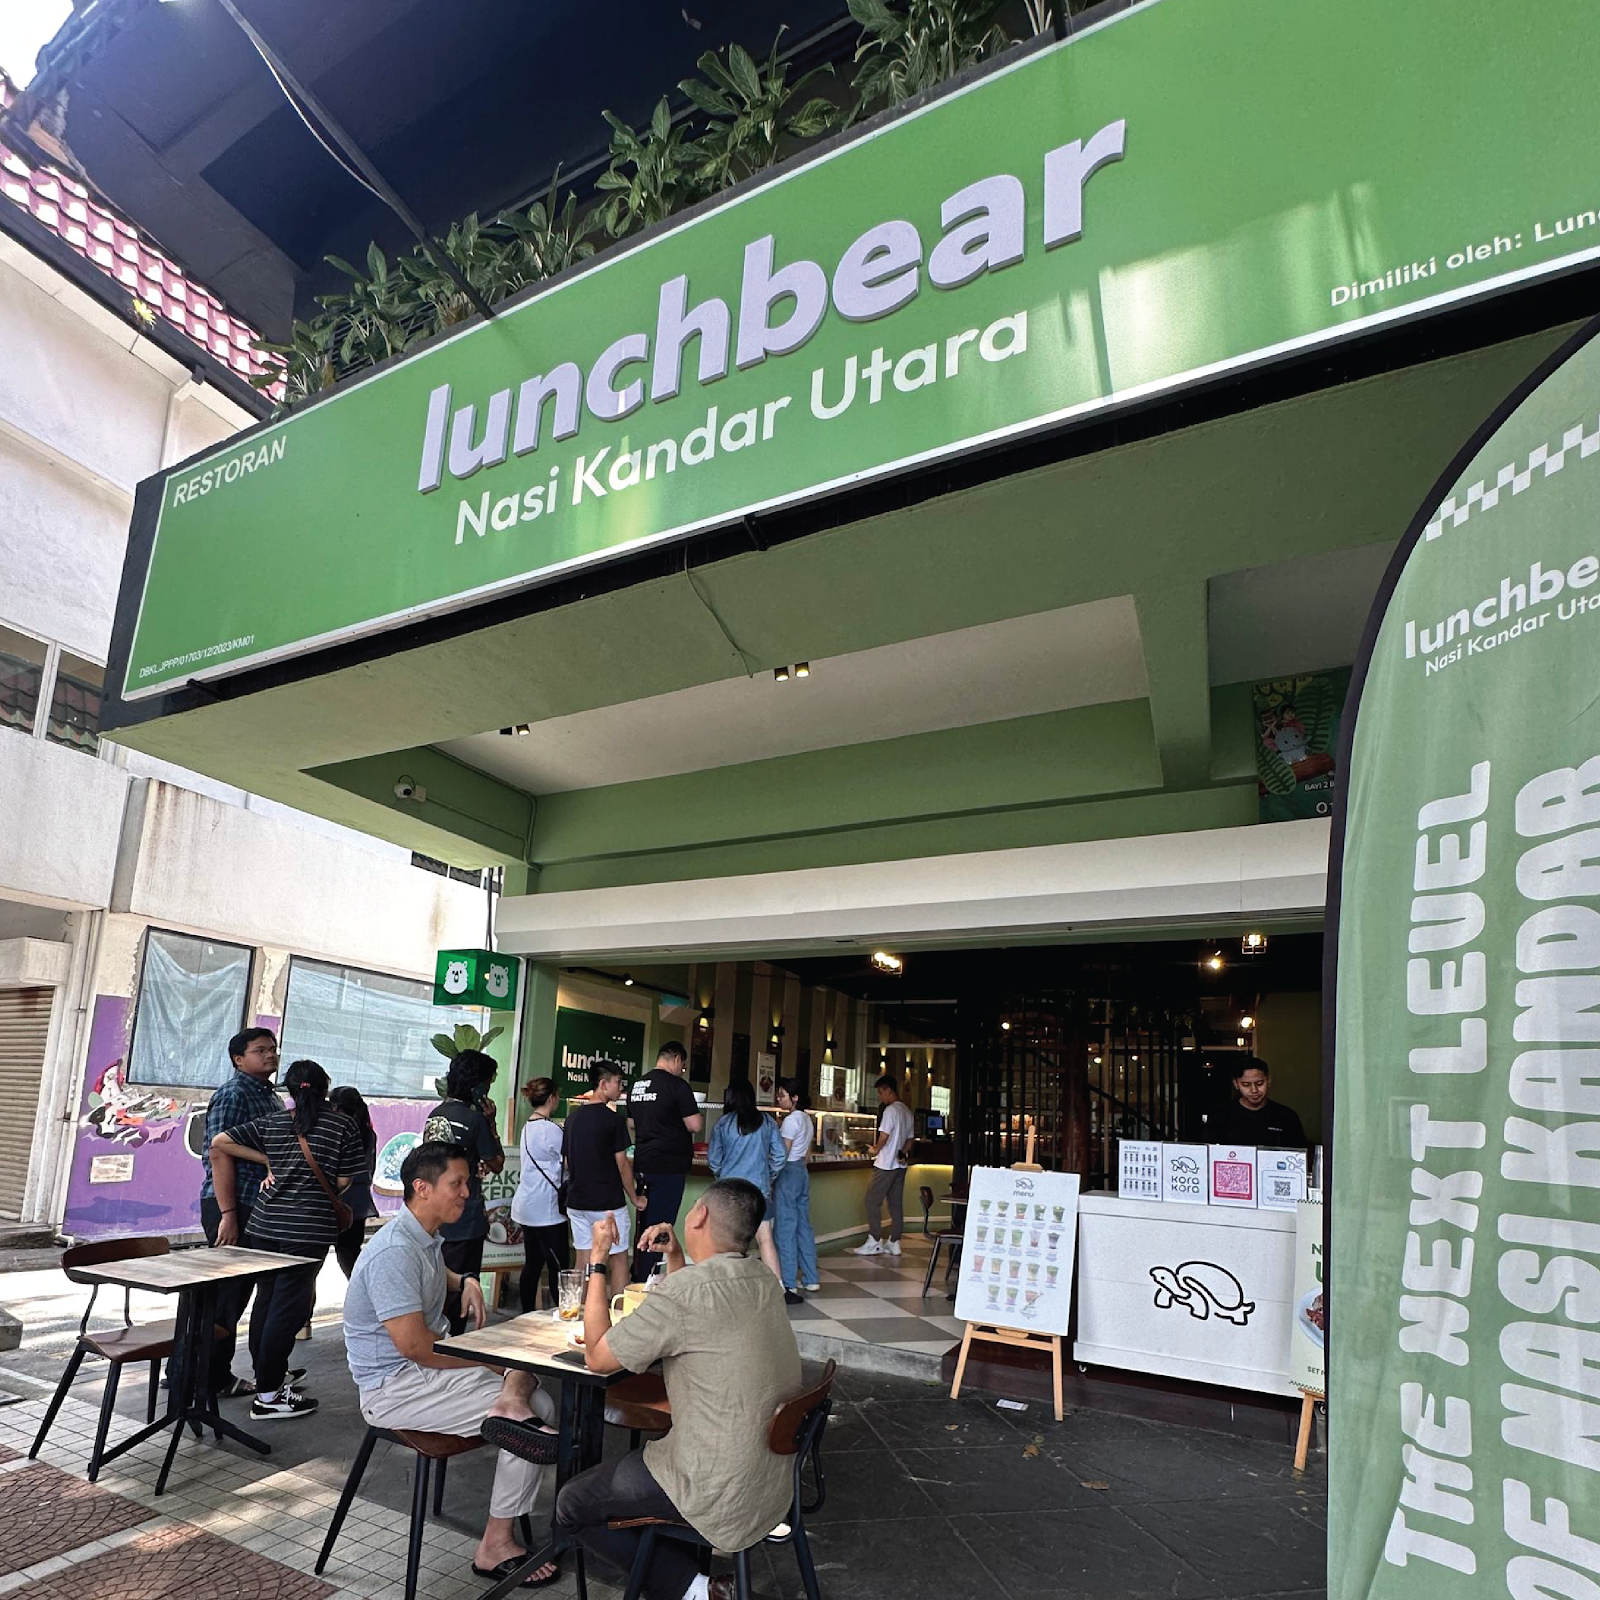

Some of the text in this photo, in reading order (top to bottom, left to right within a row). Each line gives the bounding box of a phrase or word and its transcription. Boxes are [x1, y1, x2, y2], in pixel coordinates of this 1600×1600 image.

[418, 118, 1126, 495] lunchbear
[1331, 209, 1600, 307] Dimiliki oleh: Lun
[173, 435, 287, 508] RESTORAN
[454, 310, 1027, 545] Nasi Kandar Utara
[1425, 643, 1462, 677] Nasi
[1468, 613, 1550, 656] Kandar
[1500, 753, 1600, 1188] KANDAR
[1398, 1104, 1486, 1366] NEXT
[1498, 1213, 1600, 1473] NASI
[1385, 1382, 1476, 1575] THE
